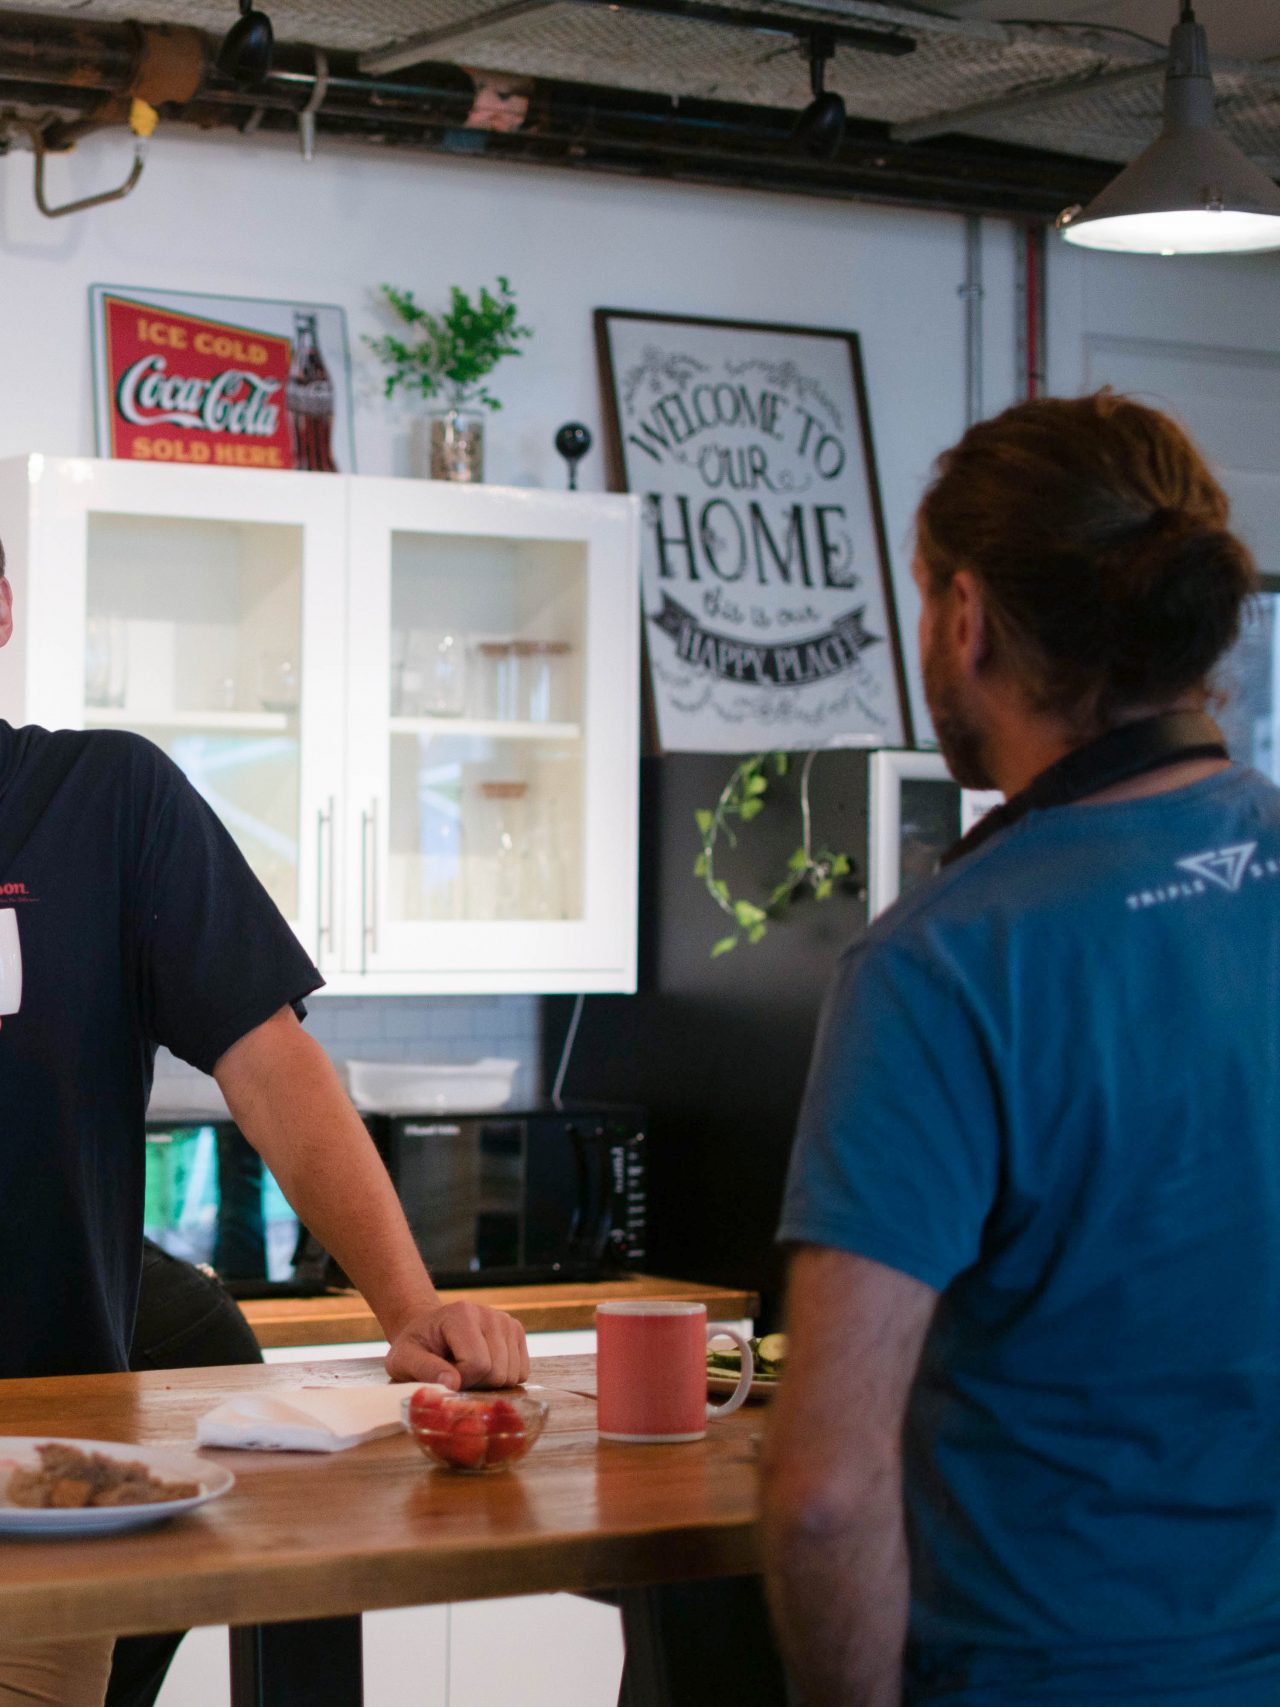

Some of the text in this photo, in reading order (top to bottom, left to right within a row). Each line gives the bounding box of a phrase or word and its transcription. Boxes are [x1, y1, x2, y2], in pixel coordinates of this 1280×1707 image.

[136, 318, 269, 365] ICE COLD
[132, 436, 284, 466] SOLD HERE
[628, 382, 846, 481] WELCOME TO
[697, 443, 782, 494] OUR
[647, 491, 859, 589] HOME
[680, 619, 769, 687] HAPPY
